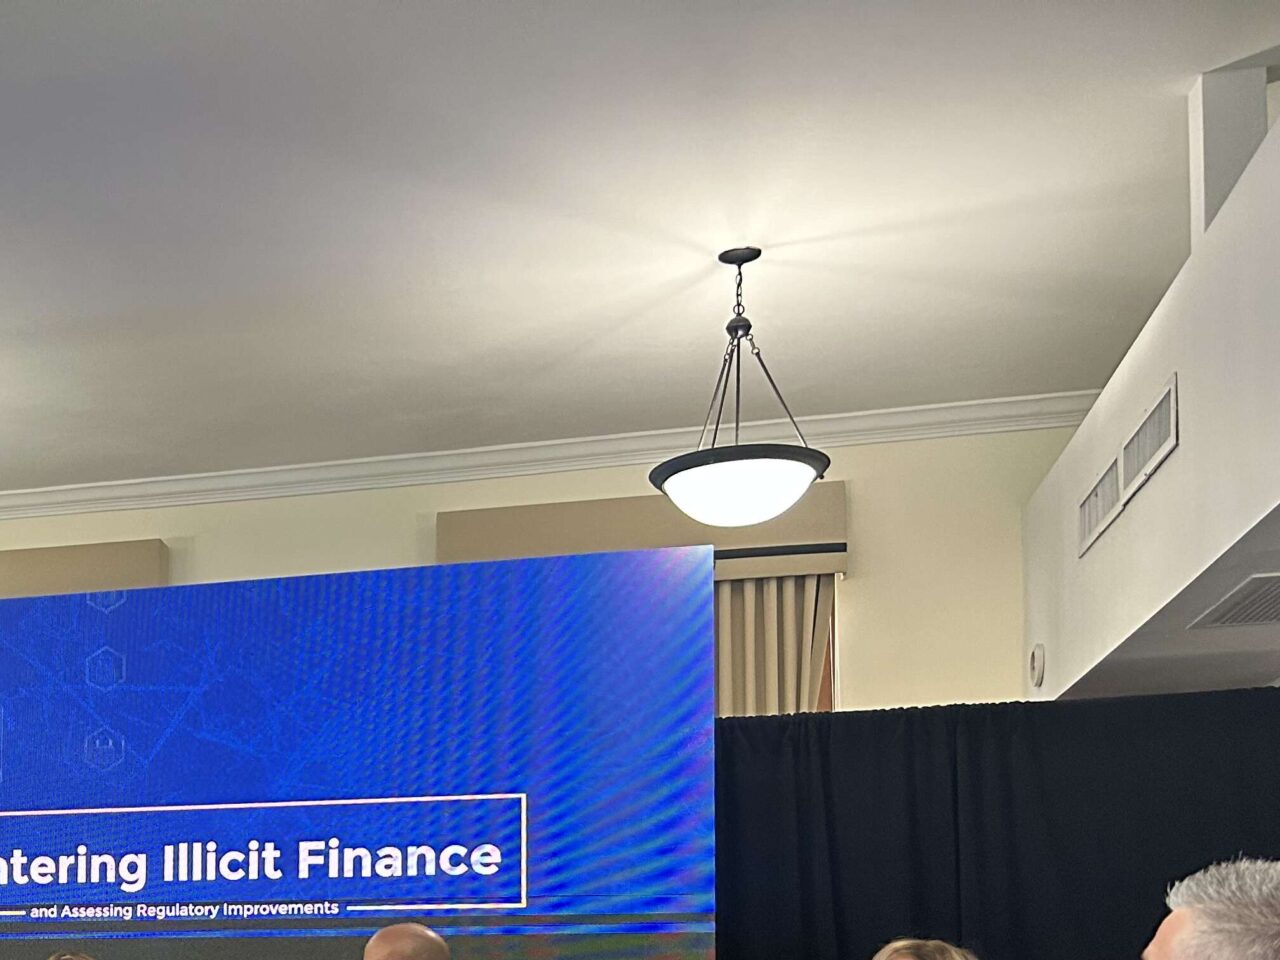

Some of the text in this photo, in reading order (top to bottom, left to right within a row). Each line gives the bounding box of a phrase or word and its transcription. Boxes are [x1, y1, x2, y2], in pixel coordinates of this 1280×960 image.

[164, 840, 283, 882] Illicit
[298, 837, 502, 879] Finance
[30, 901, 339, 920] and Assessing Regulatory Improvements
